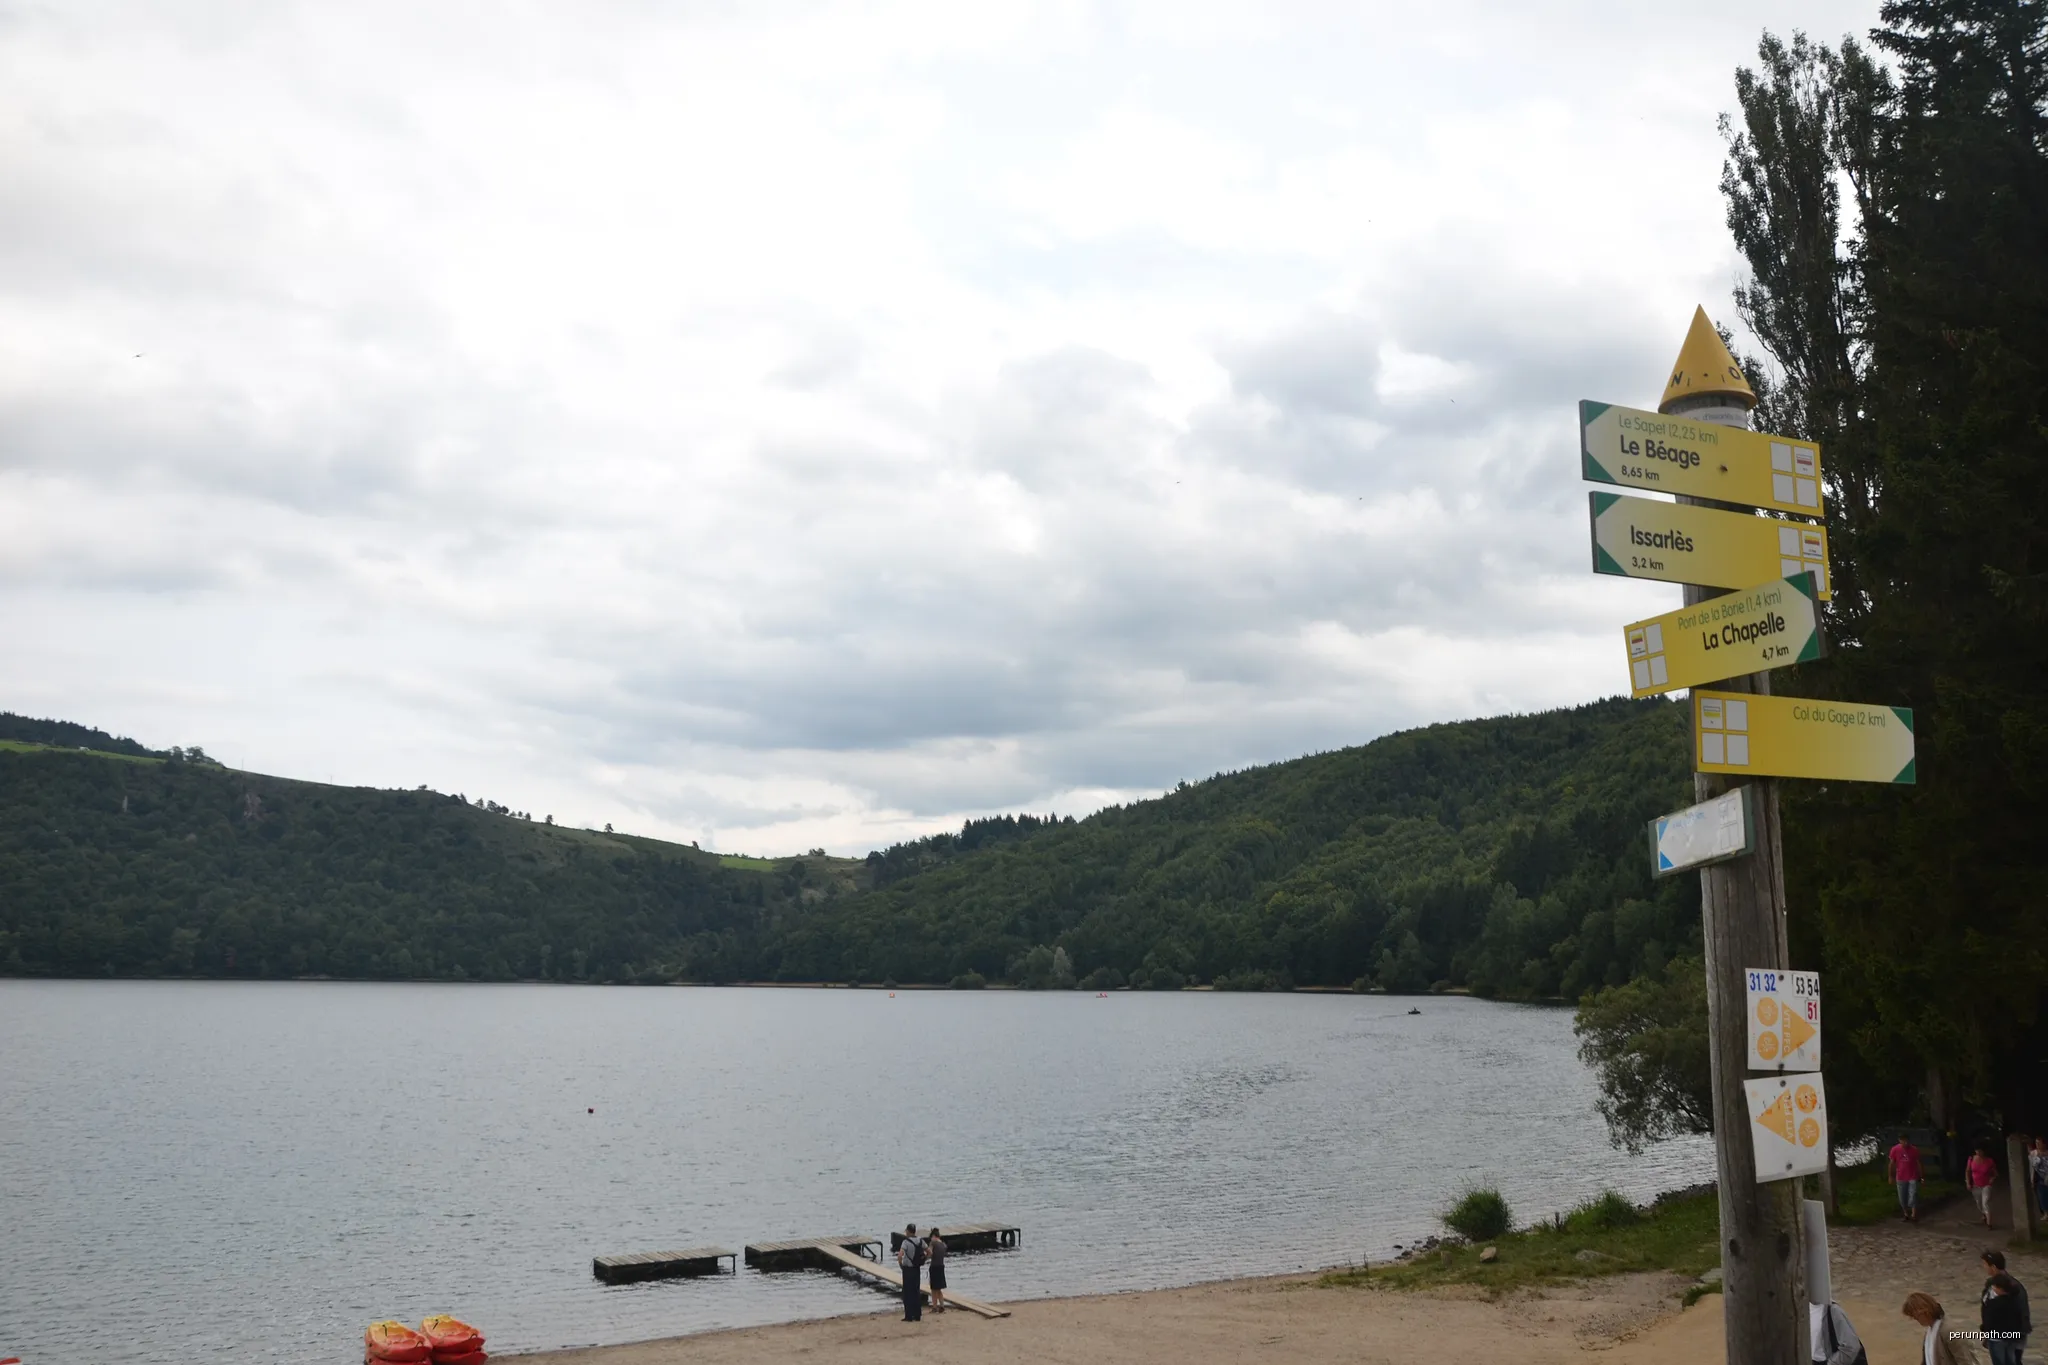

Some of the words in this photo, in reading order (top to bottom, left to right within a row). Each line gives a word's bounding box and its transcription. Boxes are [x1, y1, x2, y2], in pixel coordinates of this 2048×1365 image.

[1618, 414, 1632, 428] Le
[1634, 417, 1666, 436] Sapet
[1668, 423, 1697, 441] (2,25
[1698, 427, 1719, 446] km)
[1620, 434, 1640, 456] Le
[1645, 438, 1700, 470] Béage
[1621, 464, 1643, 479] 8,65
[1644, 468, 1660, 481] km
[1630, 524, 1694, 552] Issarlès
[1632, 556, 1647, 569] 3,2
[1649, 557, 1664, 571] km
[1677, 613, 1697, 630] Pont
[1699, 610, 1710, 625] de
[1711, 607, 1720, 621] la
[1721, 600, 1745, 619] Borie
[1763, 587, 1783, 607] km)
[1702, 631, 1720, 651] La
[1722, 611, 1786, 646] Chapelle
[1762, 647, 1774, 661] 4,7
[1775, 645, 1790, 657] km
[1793, 705, 1810, 721] Col
[1811, 708, 1826, 722] du
[1827, 709, 1855, 728] Gage
[1856, 711, 1867, 726] (2
[1868, 712, 1886, 728] km)
[1750, 972, 1761, 991] 31
[1764, 973, 1777, 992] 32
[1796, 976, 1805, 995] 53
[1807, 978, 1820, 997] 54
[1807, 1001, 1818, 1021] 51
